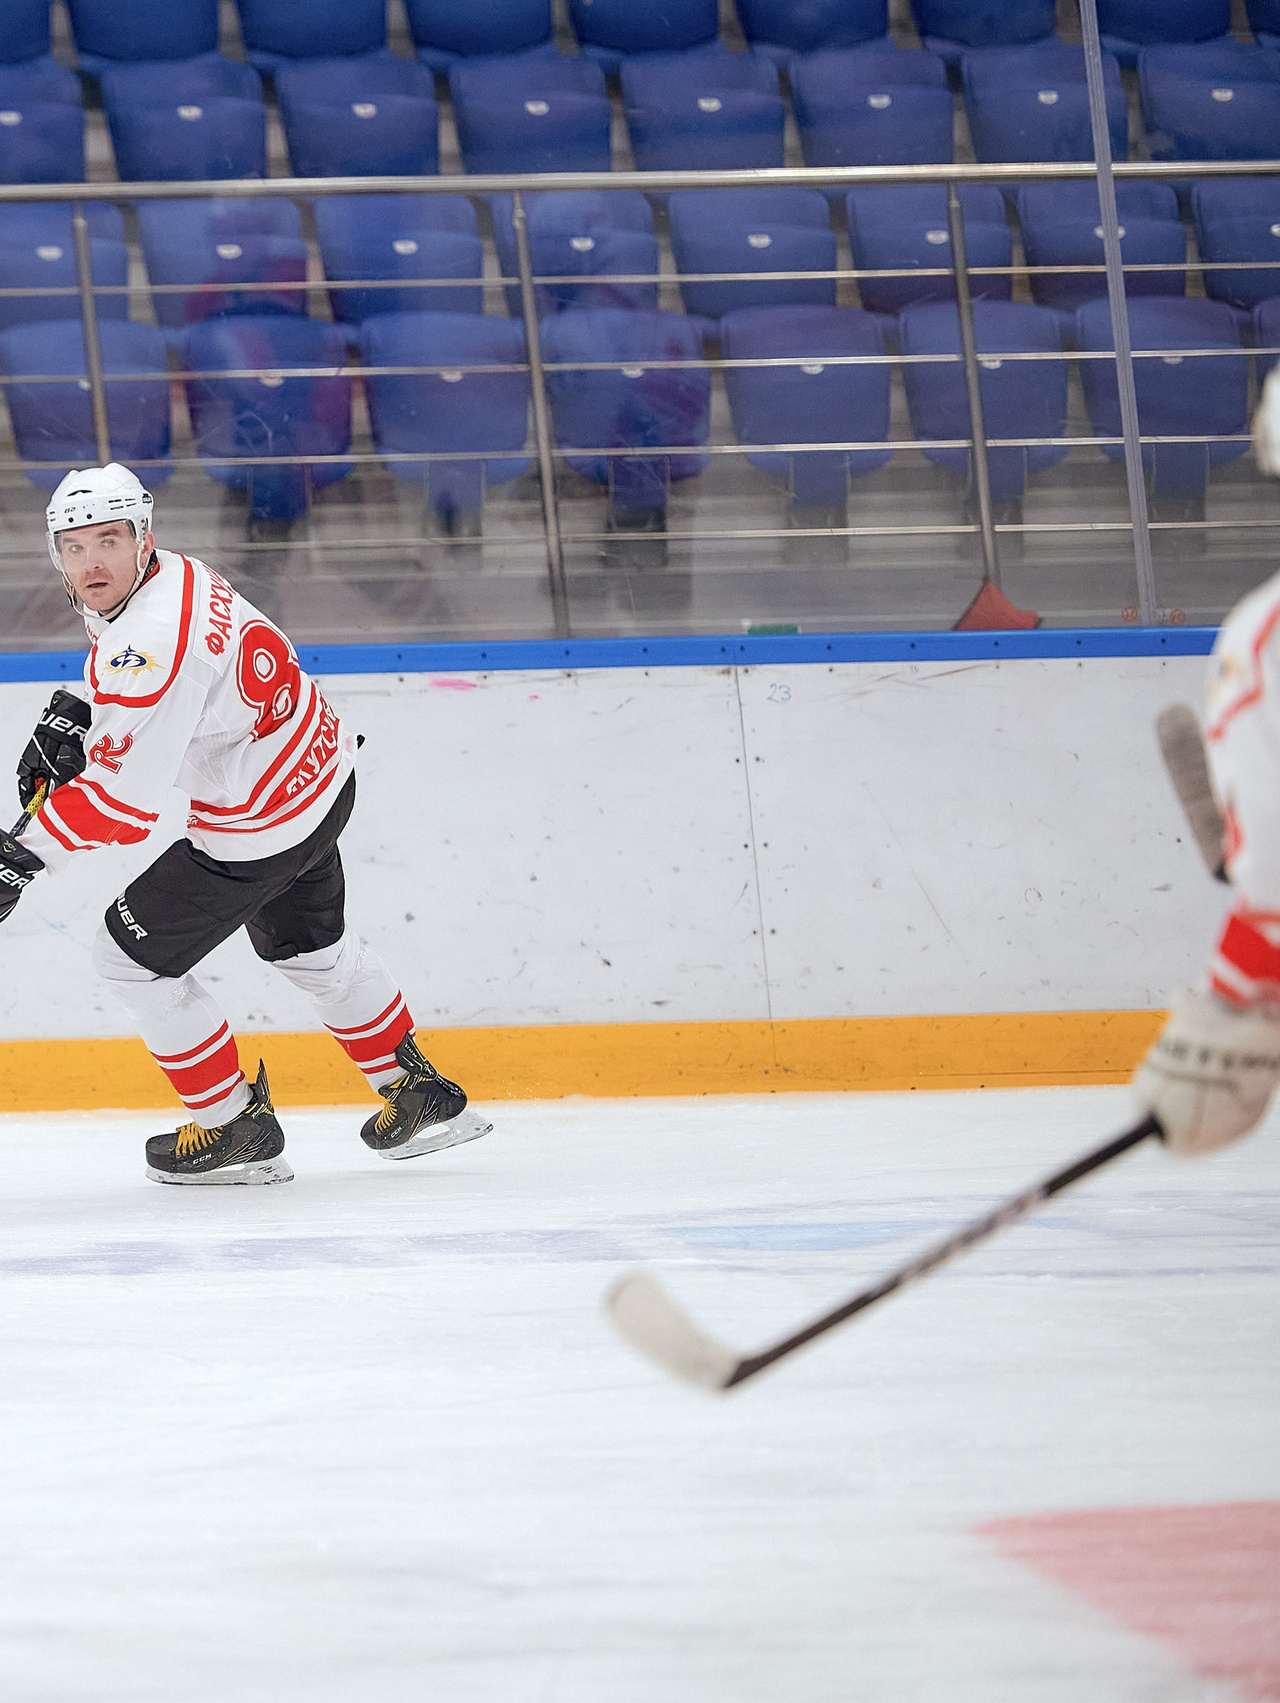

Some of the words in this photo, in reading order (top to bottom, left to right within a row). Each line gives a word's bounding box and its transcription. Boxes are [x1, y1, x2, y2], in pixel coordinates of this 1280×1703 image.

[202, 564, 237, 656] ФАСХУ
[766, 682, 792, 703] 23
[117, 893, 149, 941] UER
[192, 1153, 212, 1165] CCM
